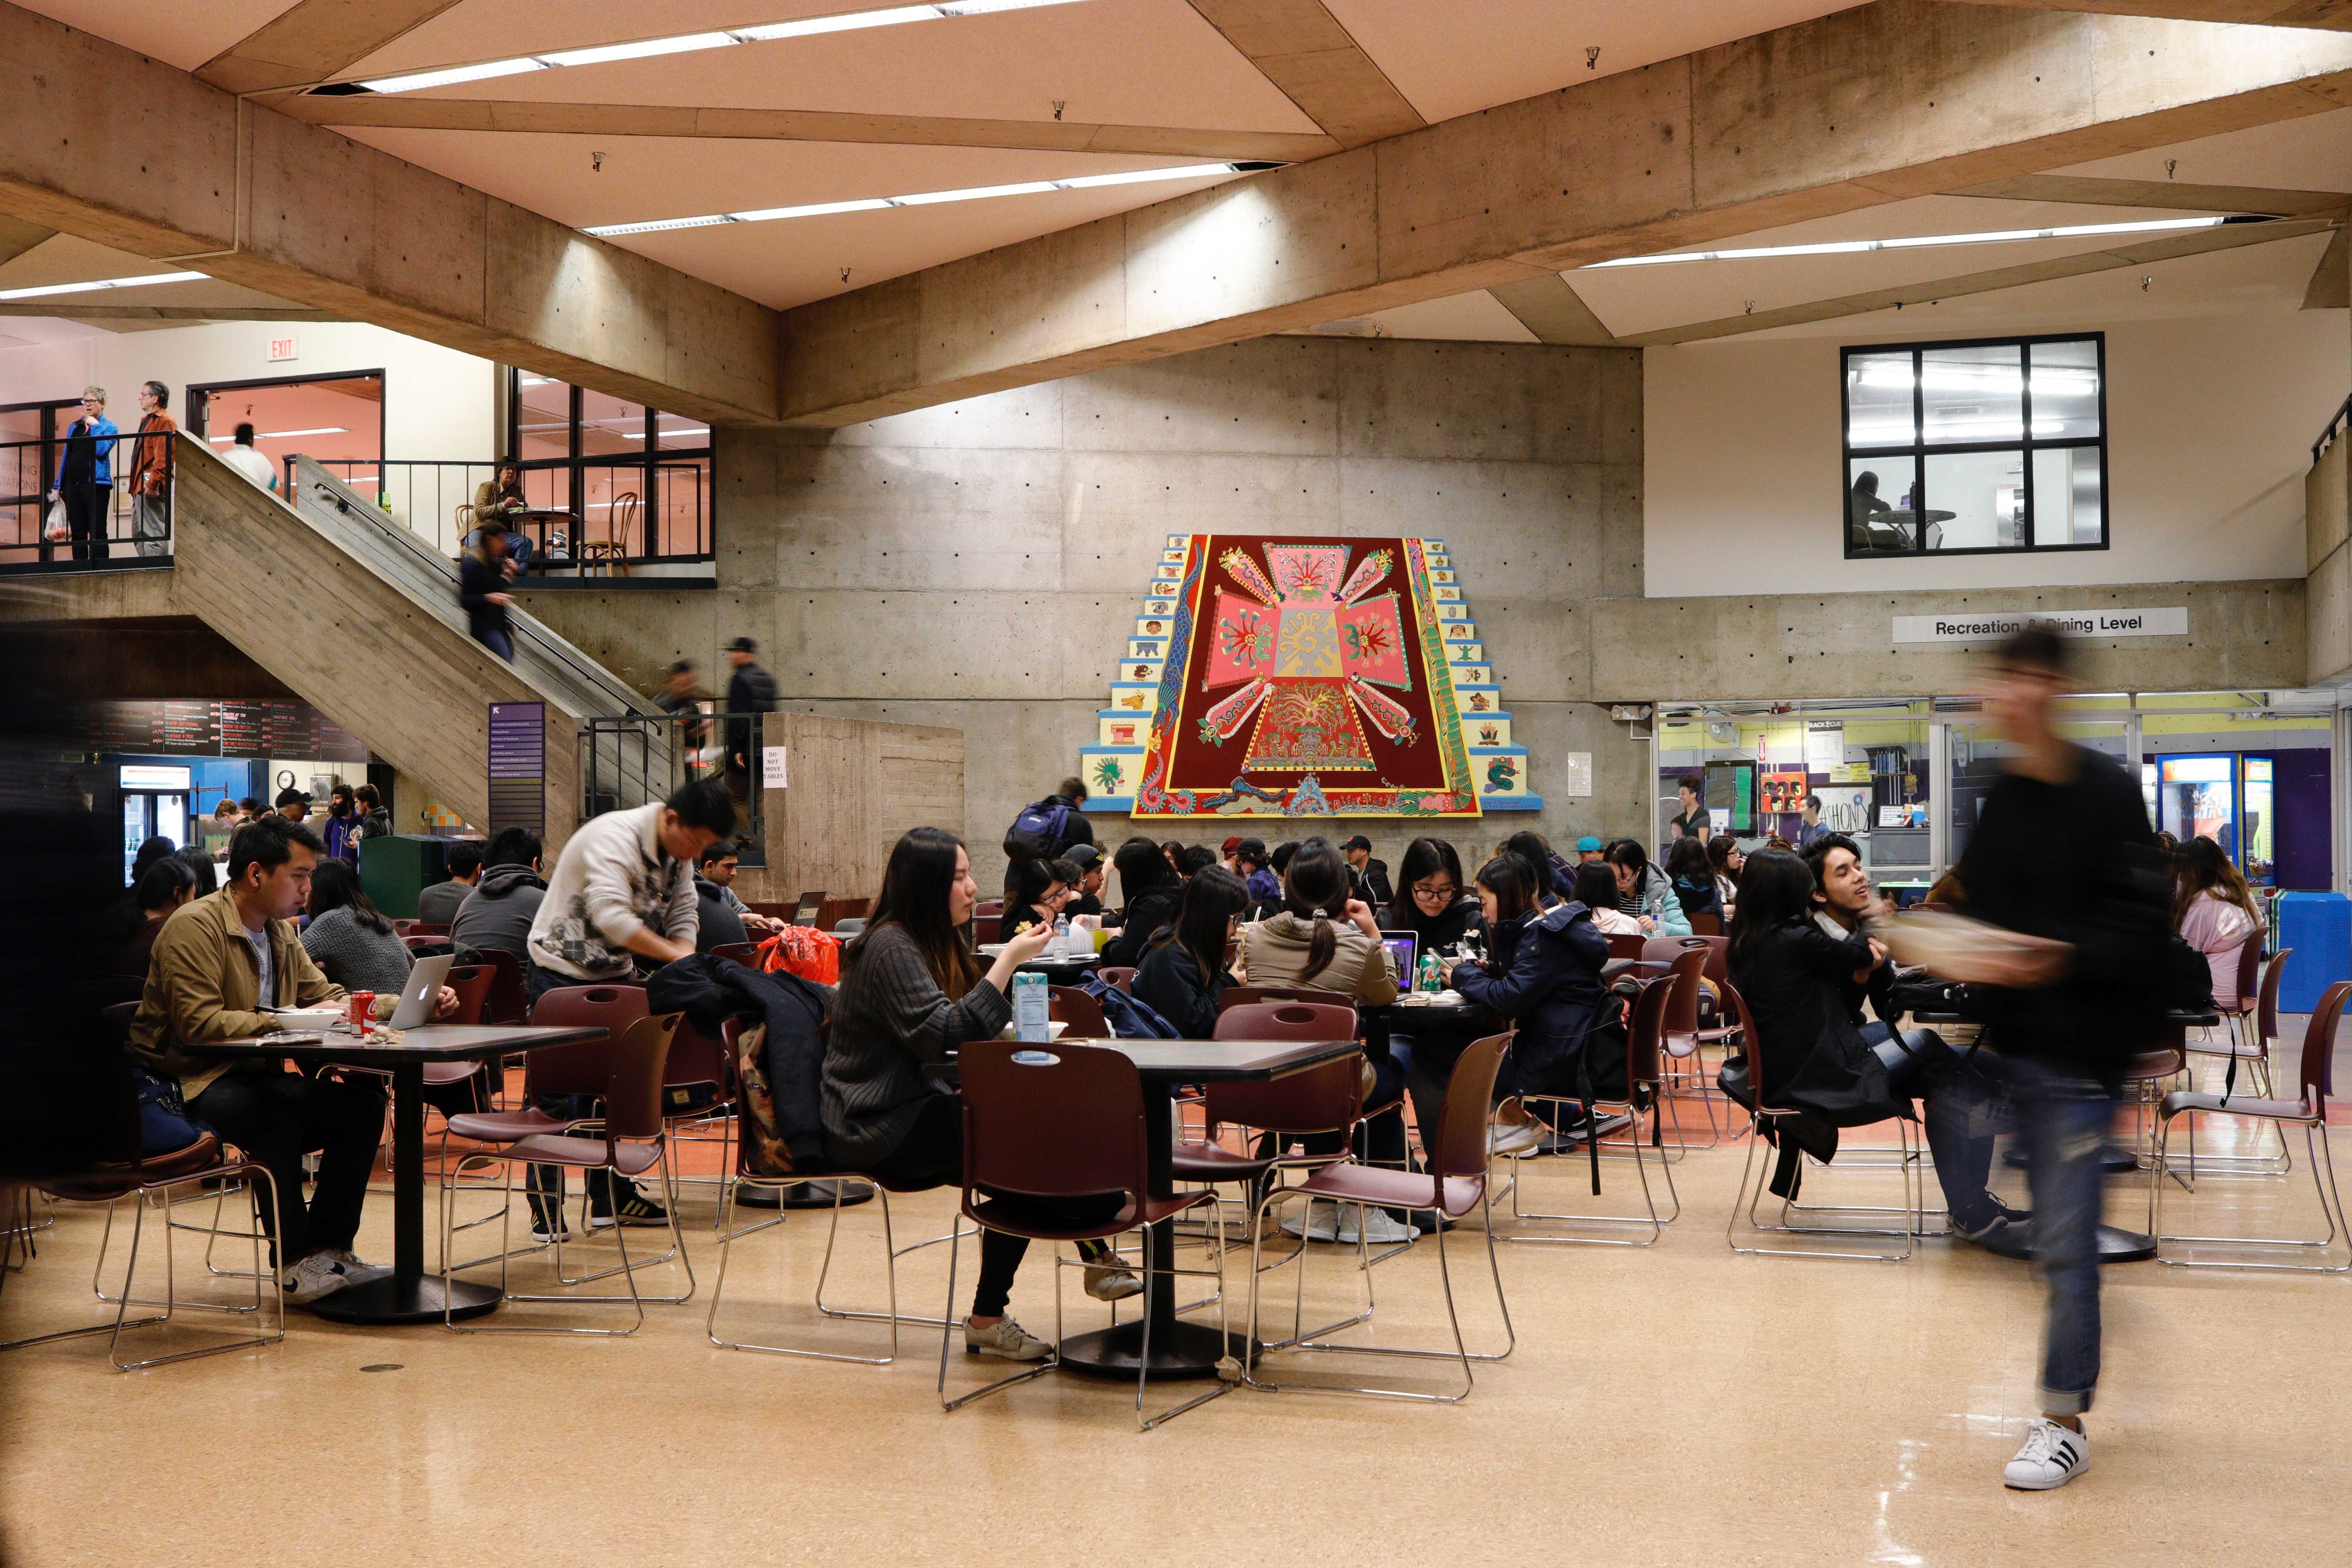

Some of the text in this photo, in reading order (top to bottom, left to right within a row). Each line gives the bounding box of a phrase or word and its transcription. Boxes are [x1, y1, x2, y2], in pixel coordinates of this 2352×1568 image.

[272, 339, 292, 358] EXIT
[1936, 620, 2020, 634] Recreation
[2045, 618, 2094, 633] Dining
[2100, 615, 2142, 630] Level
[1764, 785, 1802, 796] 1 2 3
[1775, 799, 1797, 811] 4 5
